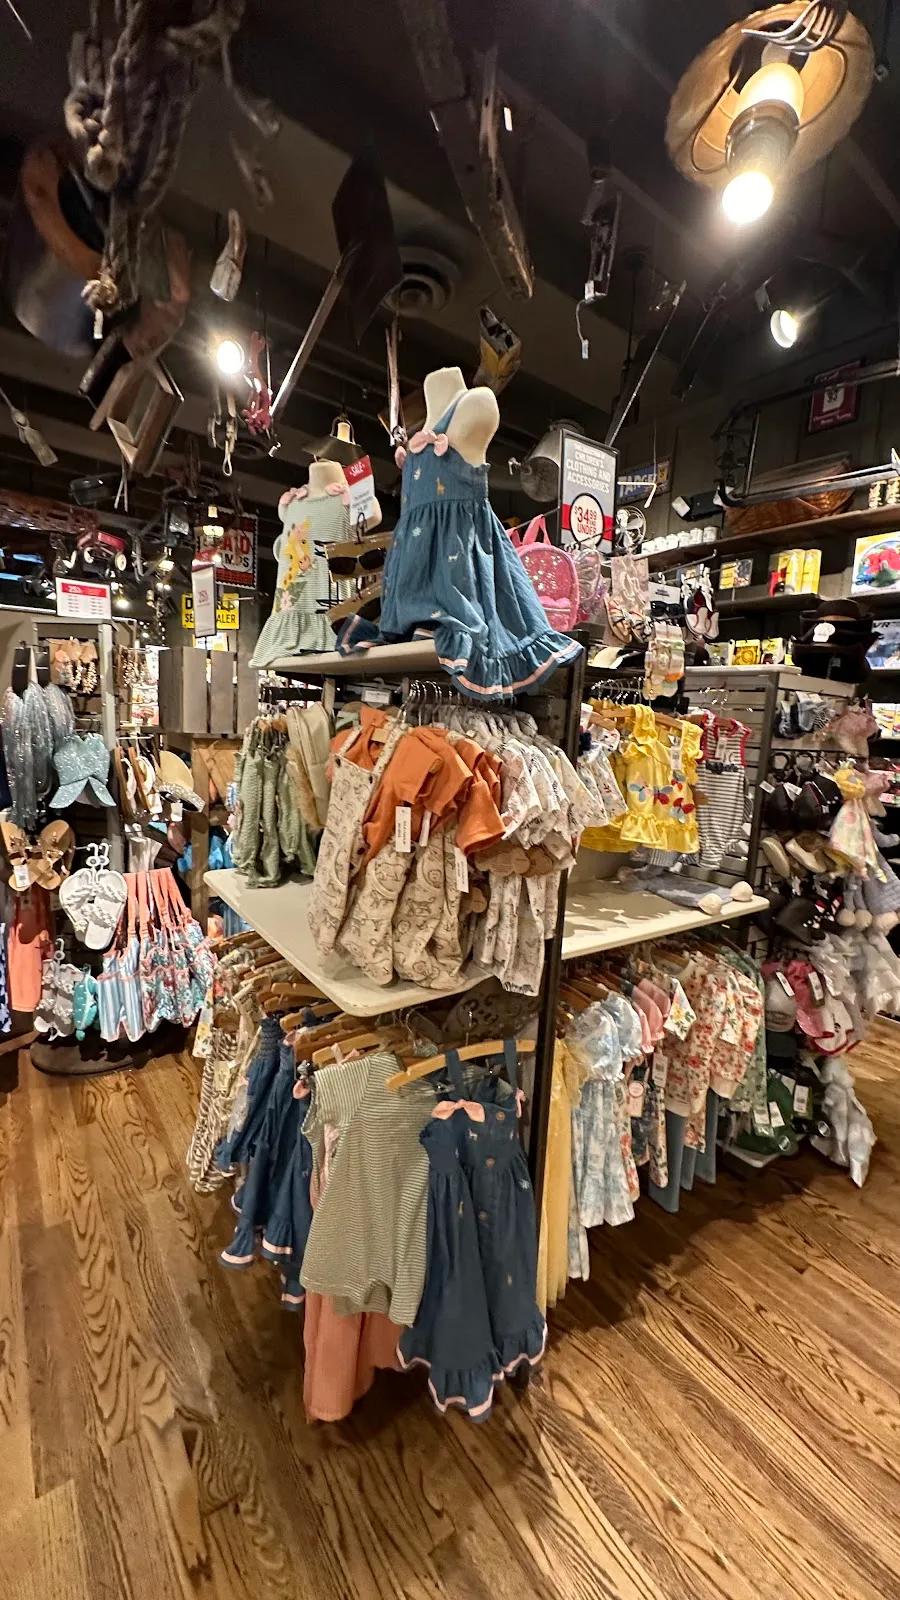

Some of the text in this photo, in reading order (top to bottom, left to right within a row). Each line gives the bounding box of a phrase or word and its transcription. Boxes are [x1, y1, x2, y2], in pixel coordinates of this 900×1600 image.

[575, 450, 604, 469] CHILDREN'S
[566, 459, 611, 482] CLOTHING AND
[567, 472, 609, 494] ACCESSORIES
[577, 523, 597, 536] UNDER
